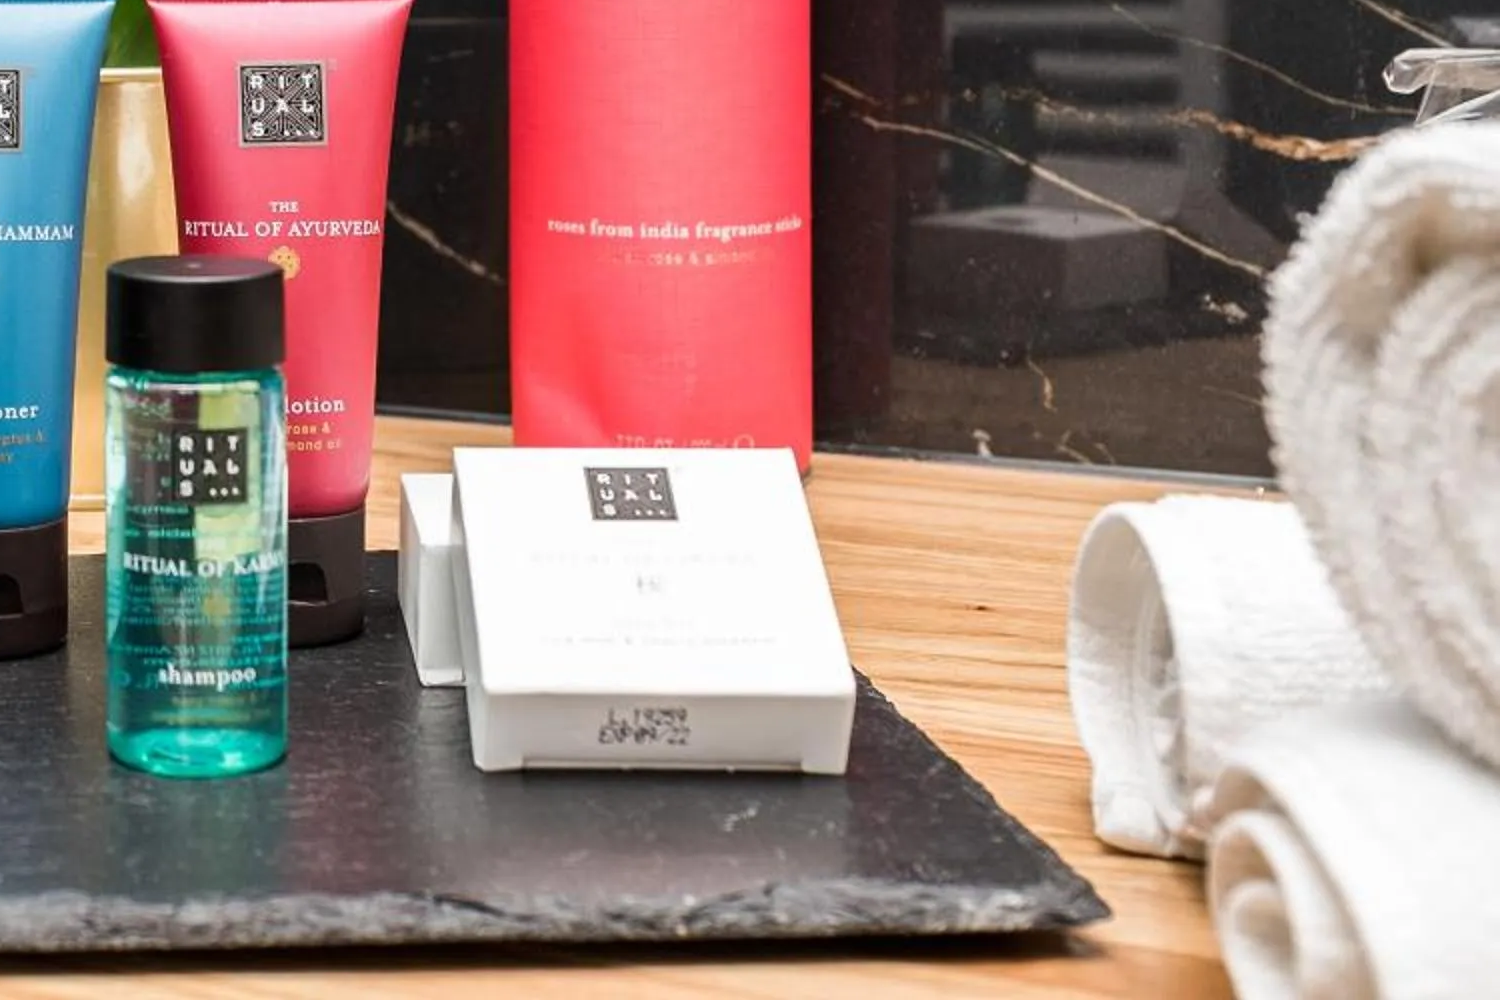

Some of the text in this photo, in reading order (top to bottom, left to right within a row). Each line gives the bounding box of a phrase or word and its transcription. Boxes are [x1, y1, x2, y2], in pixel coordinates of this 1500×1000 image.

[269, 201, 299, 214] THE
[185, 221, 381, 238] RITUAL OF AYURVEDA
[548, 219, 585, 234] roses
[590, 218, 634, 239] from
[640, 221, 689, 240] india
[696, 219, 773, 244] fragrance
[123, 551, 193, 578] RITUAL
[197, 559, 226, 578] OF
[157, 661, 258, 693] shampoo
